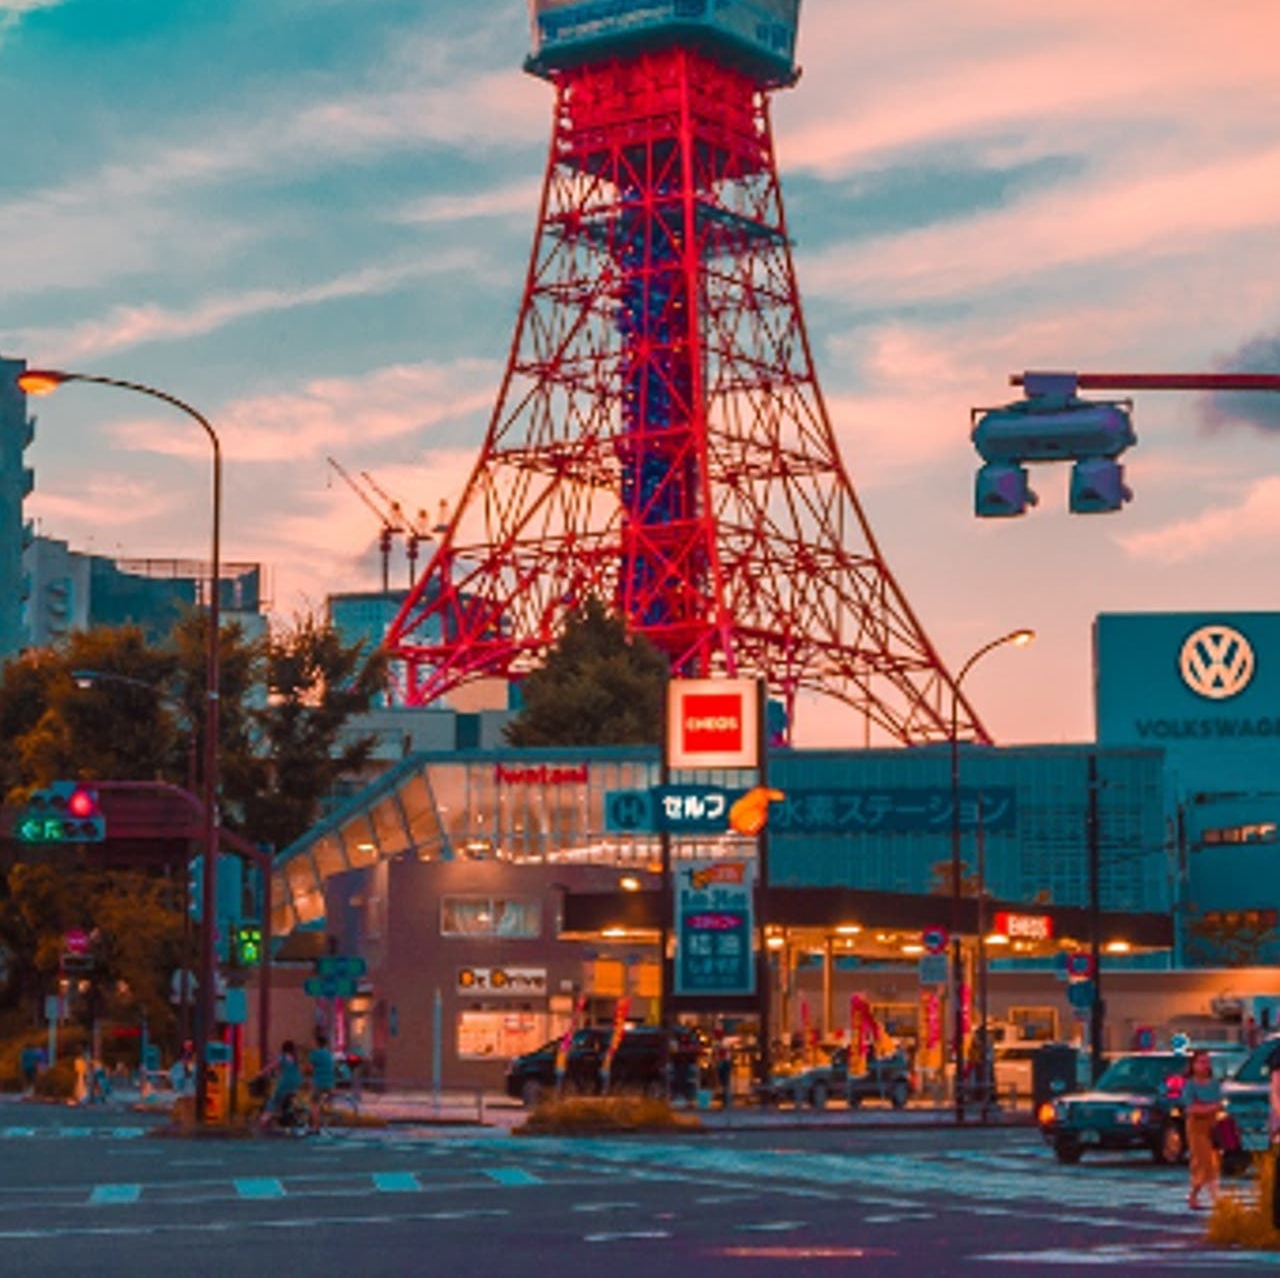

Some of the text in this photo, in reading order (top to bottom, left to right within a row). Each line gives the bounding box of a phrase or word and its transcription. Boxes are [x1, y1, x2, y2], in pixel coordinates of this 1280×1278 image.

[686, 716, 739, 731] ENEOS
[663, 794, 726, 820] セルフ
